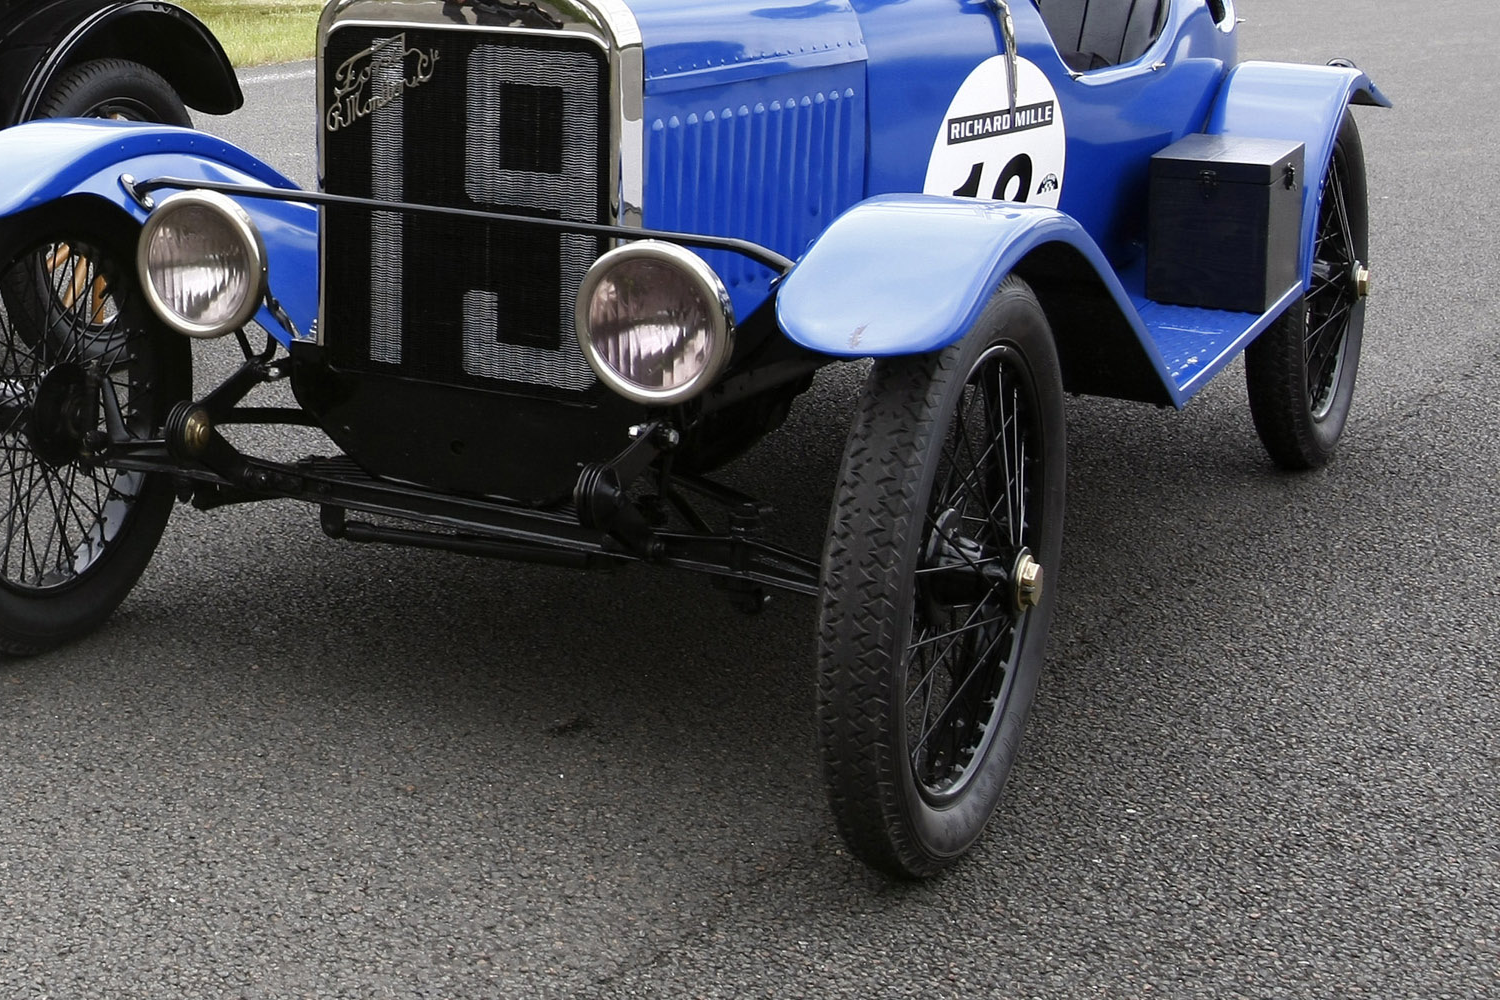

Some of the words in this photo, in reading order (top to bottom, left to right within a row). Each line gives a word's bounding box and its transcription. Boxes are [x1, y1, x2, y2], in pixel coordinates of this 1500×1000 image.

[334, 31, 406, 97] Ford
[950, 113, 1011, 139] RICHARD
[1015, 105, 1052, 127] MILLE
[370, 37, 598, 392] 19
